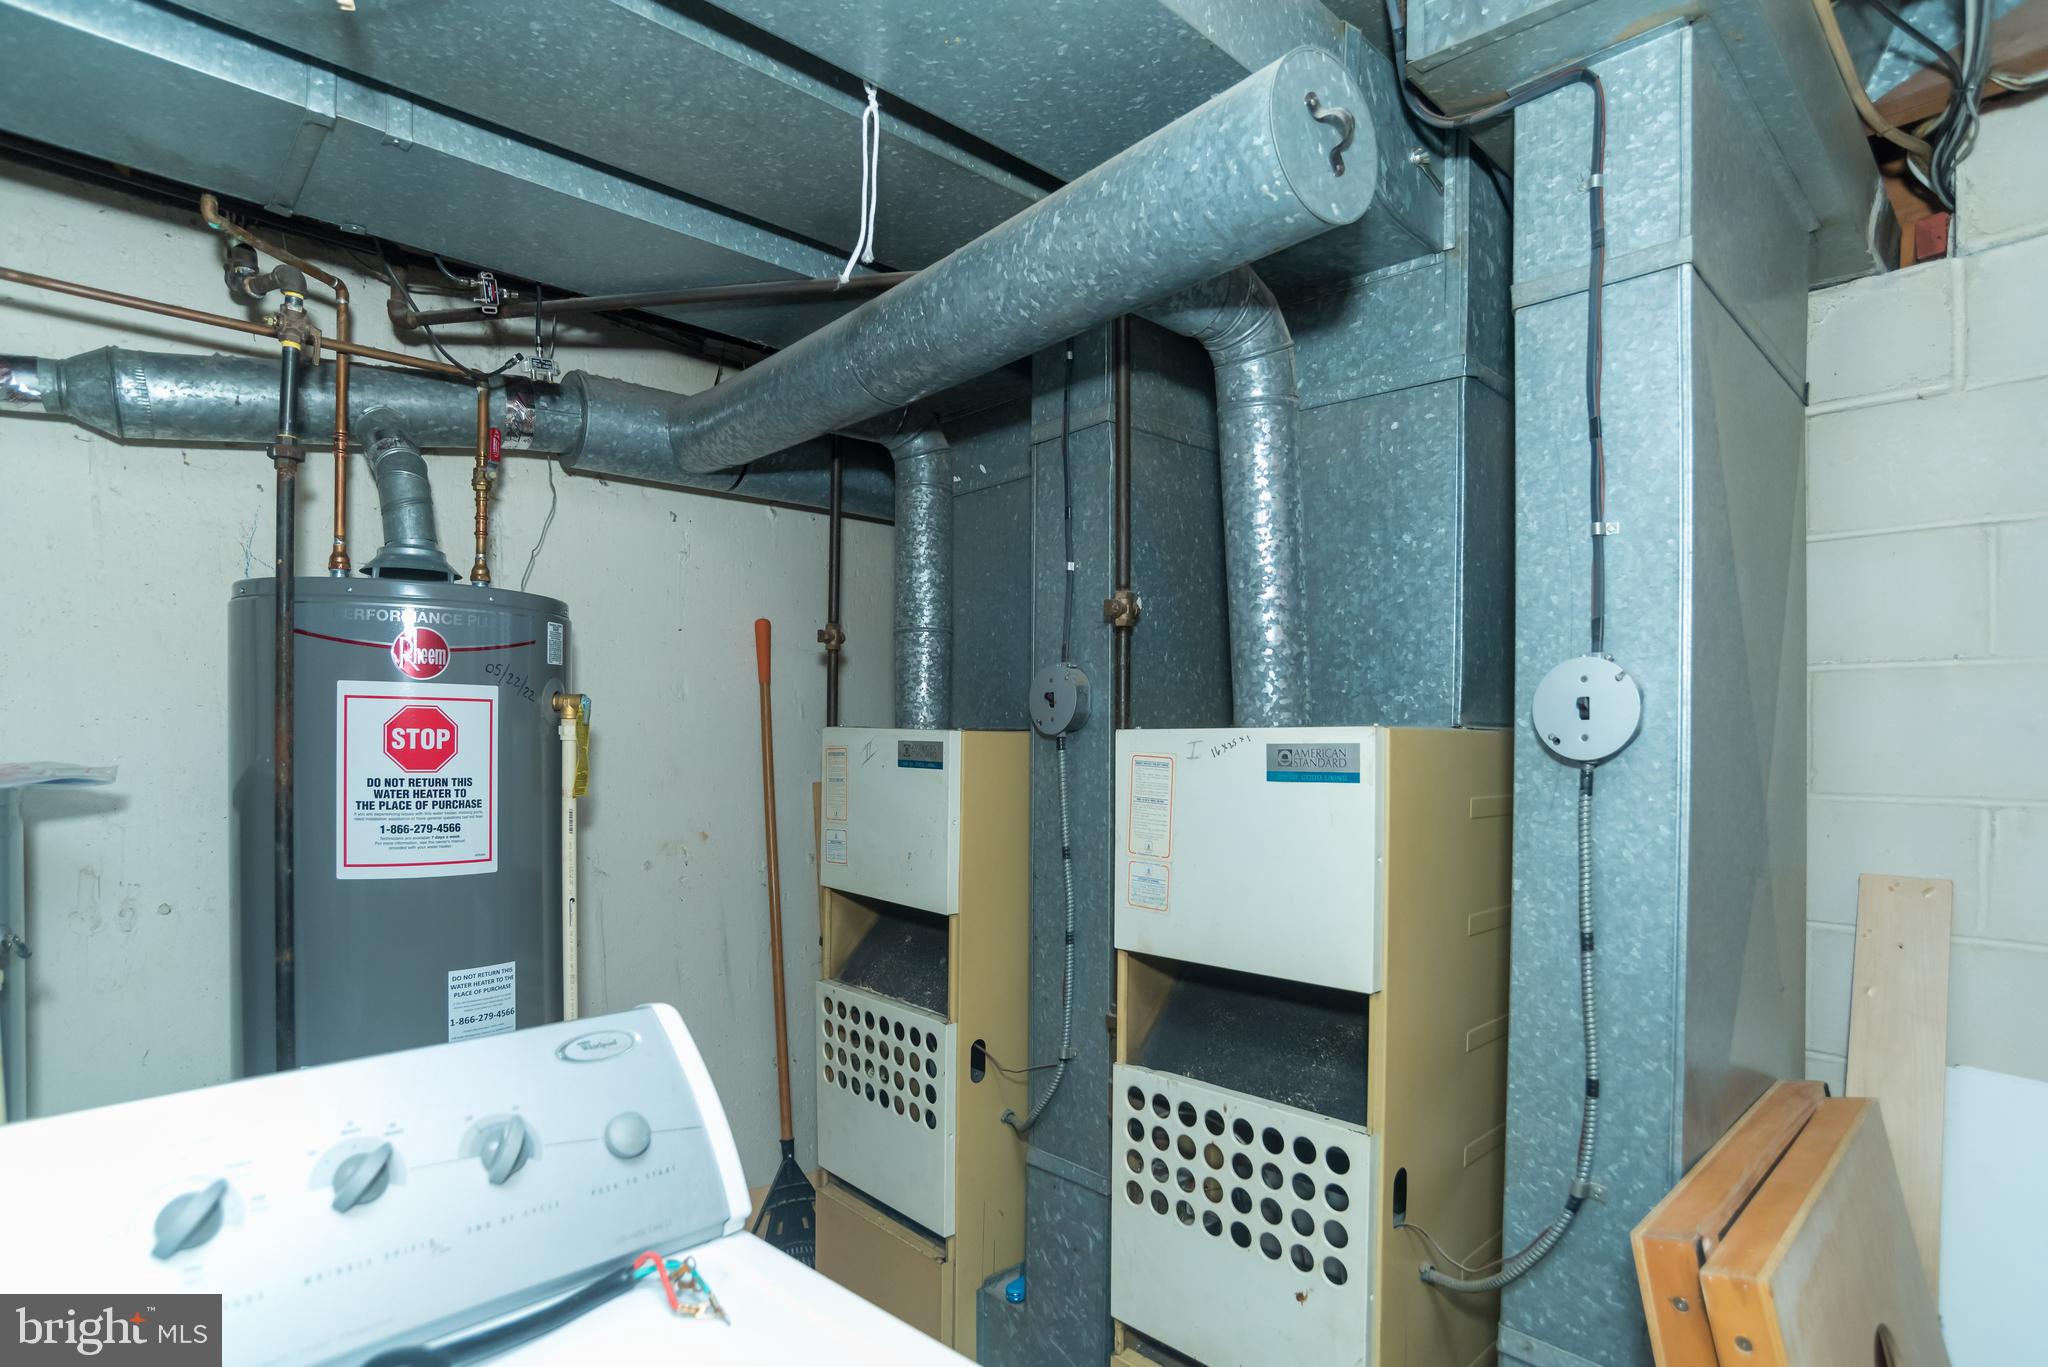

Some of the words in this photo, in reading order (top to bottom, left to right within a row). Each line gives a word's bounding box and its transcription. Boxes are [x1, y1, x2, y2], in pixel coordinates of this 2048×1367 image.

[399, 633, 447, 672] Rheem
[485, 663, 535, 702] 05/22/22
[391, 727, 451, 750] STOP
[1293, 748, 1347, 758] AMERICAN
[1293, 758, 1347, 768] STANDARD
[367, 777, 381, 788] DO
[384, 777, 405, 788] NOT
[408, 777, 449, 788] RETURN
[451, 777, 473, 787] THIS
[373, 789, 410, 799] WATER
[412, 788, 452, 799] HEATER
[454, 788, 467, 798] TO
[355, 800, 376, 811] THE
[379, 800, 412, 811] PLACE
[415, 799, 428, 810] OF
[431, 799, 483, 810] PURCHASE
[380, 823, 461, 834] 1-866-279-4566
[477, 970, 501, 978] RETURN
[473, 979, 495, 987] HEATER
[483, 983, 512, 993] PURCHASE
[450, 1007, 515, 1027] 1-866-279-4566
